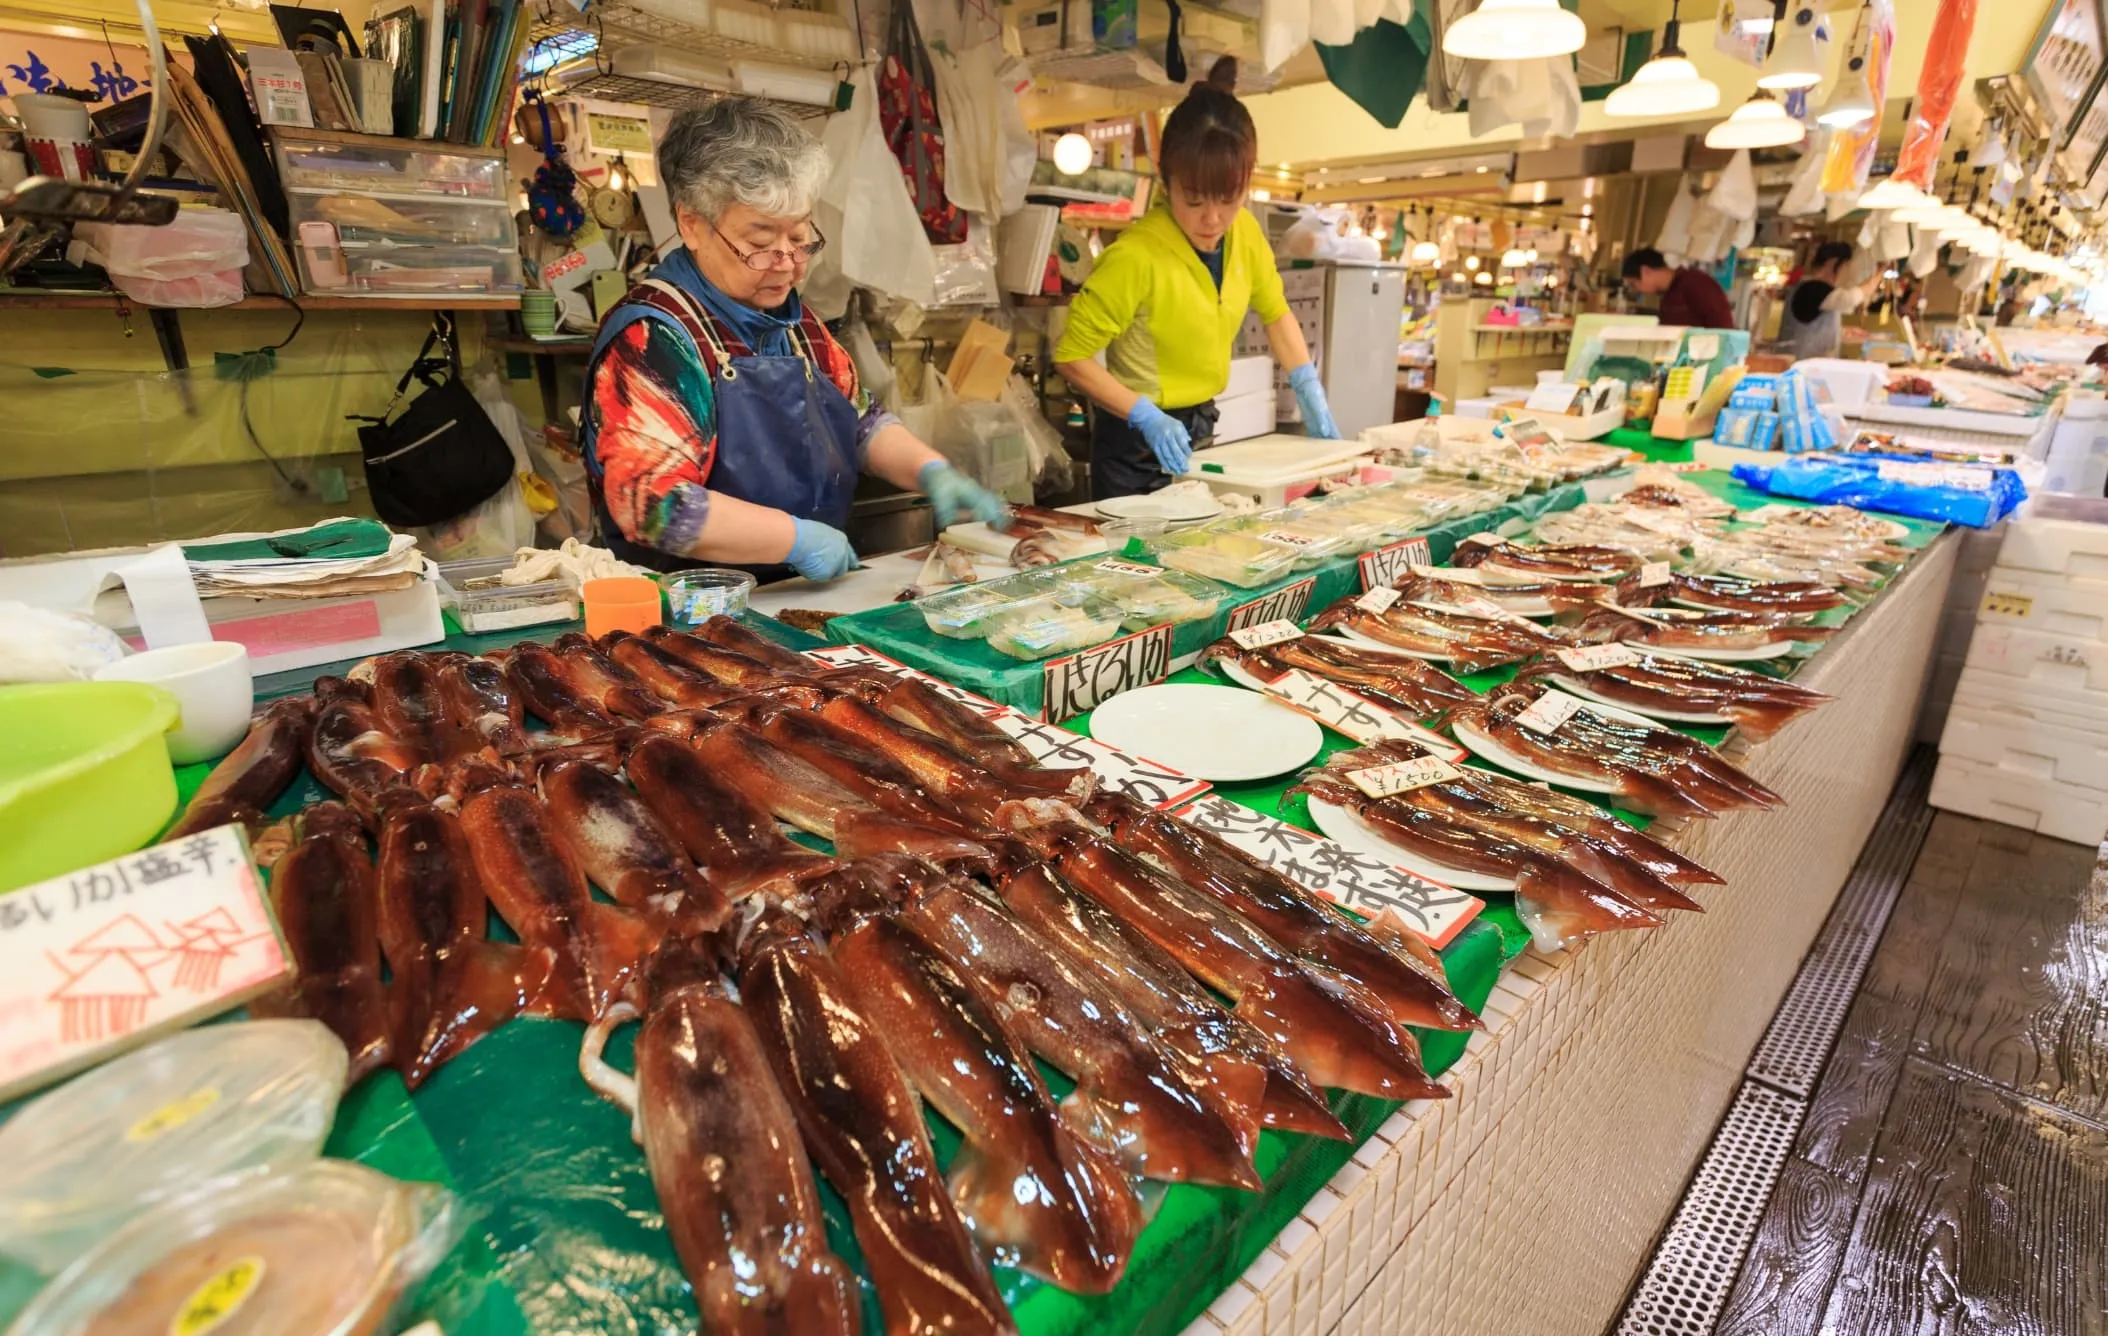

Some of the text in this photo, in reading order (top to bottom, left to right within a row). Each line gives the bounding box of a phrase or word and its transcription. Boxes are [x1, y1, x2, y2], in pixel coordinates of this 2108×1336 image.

[1264, 669, 1457, 751] いけす
[1012, 714, 1194, 803] けすか
[1203, 799, 1483, 911] 地方発送
